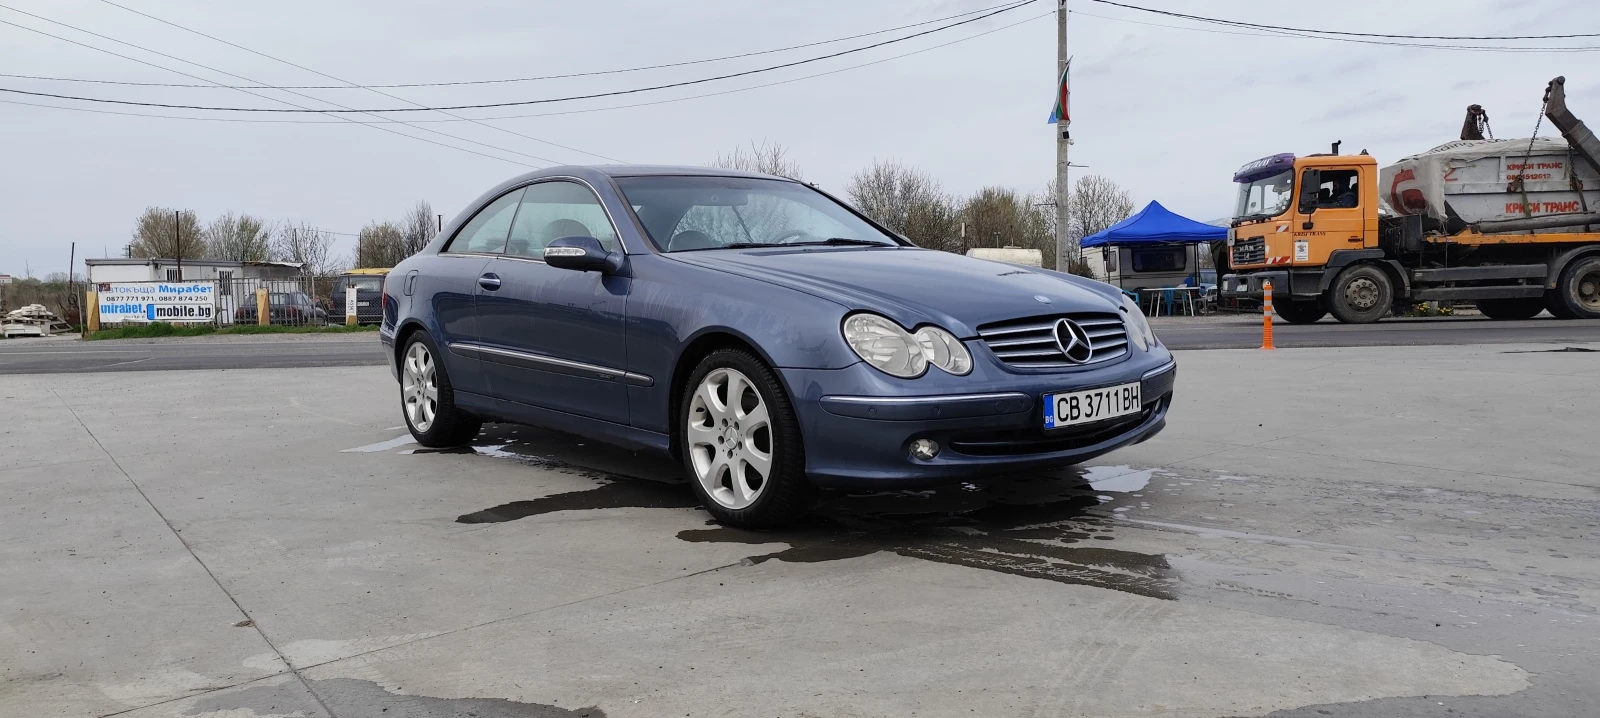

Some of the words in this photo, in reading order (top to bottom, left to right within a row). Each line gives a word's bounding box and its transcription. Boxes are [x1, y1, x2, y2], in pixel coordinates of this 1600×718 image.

[1543, 201, 1579, 212] ТРАНС
[100, 284, 155, 294] втокъща
[158, 284, 213, 295] Мирабет
[156, 305, 211, 317] mobile.bg
[1057, 396, 1081, 422] CB
[1045, 415, 1054, 424] BG
